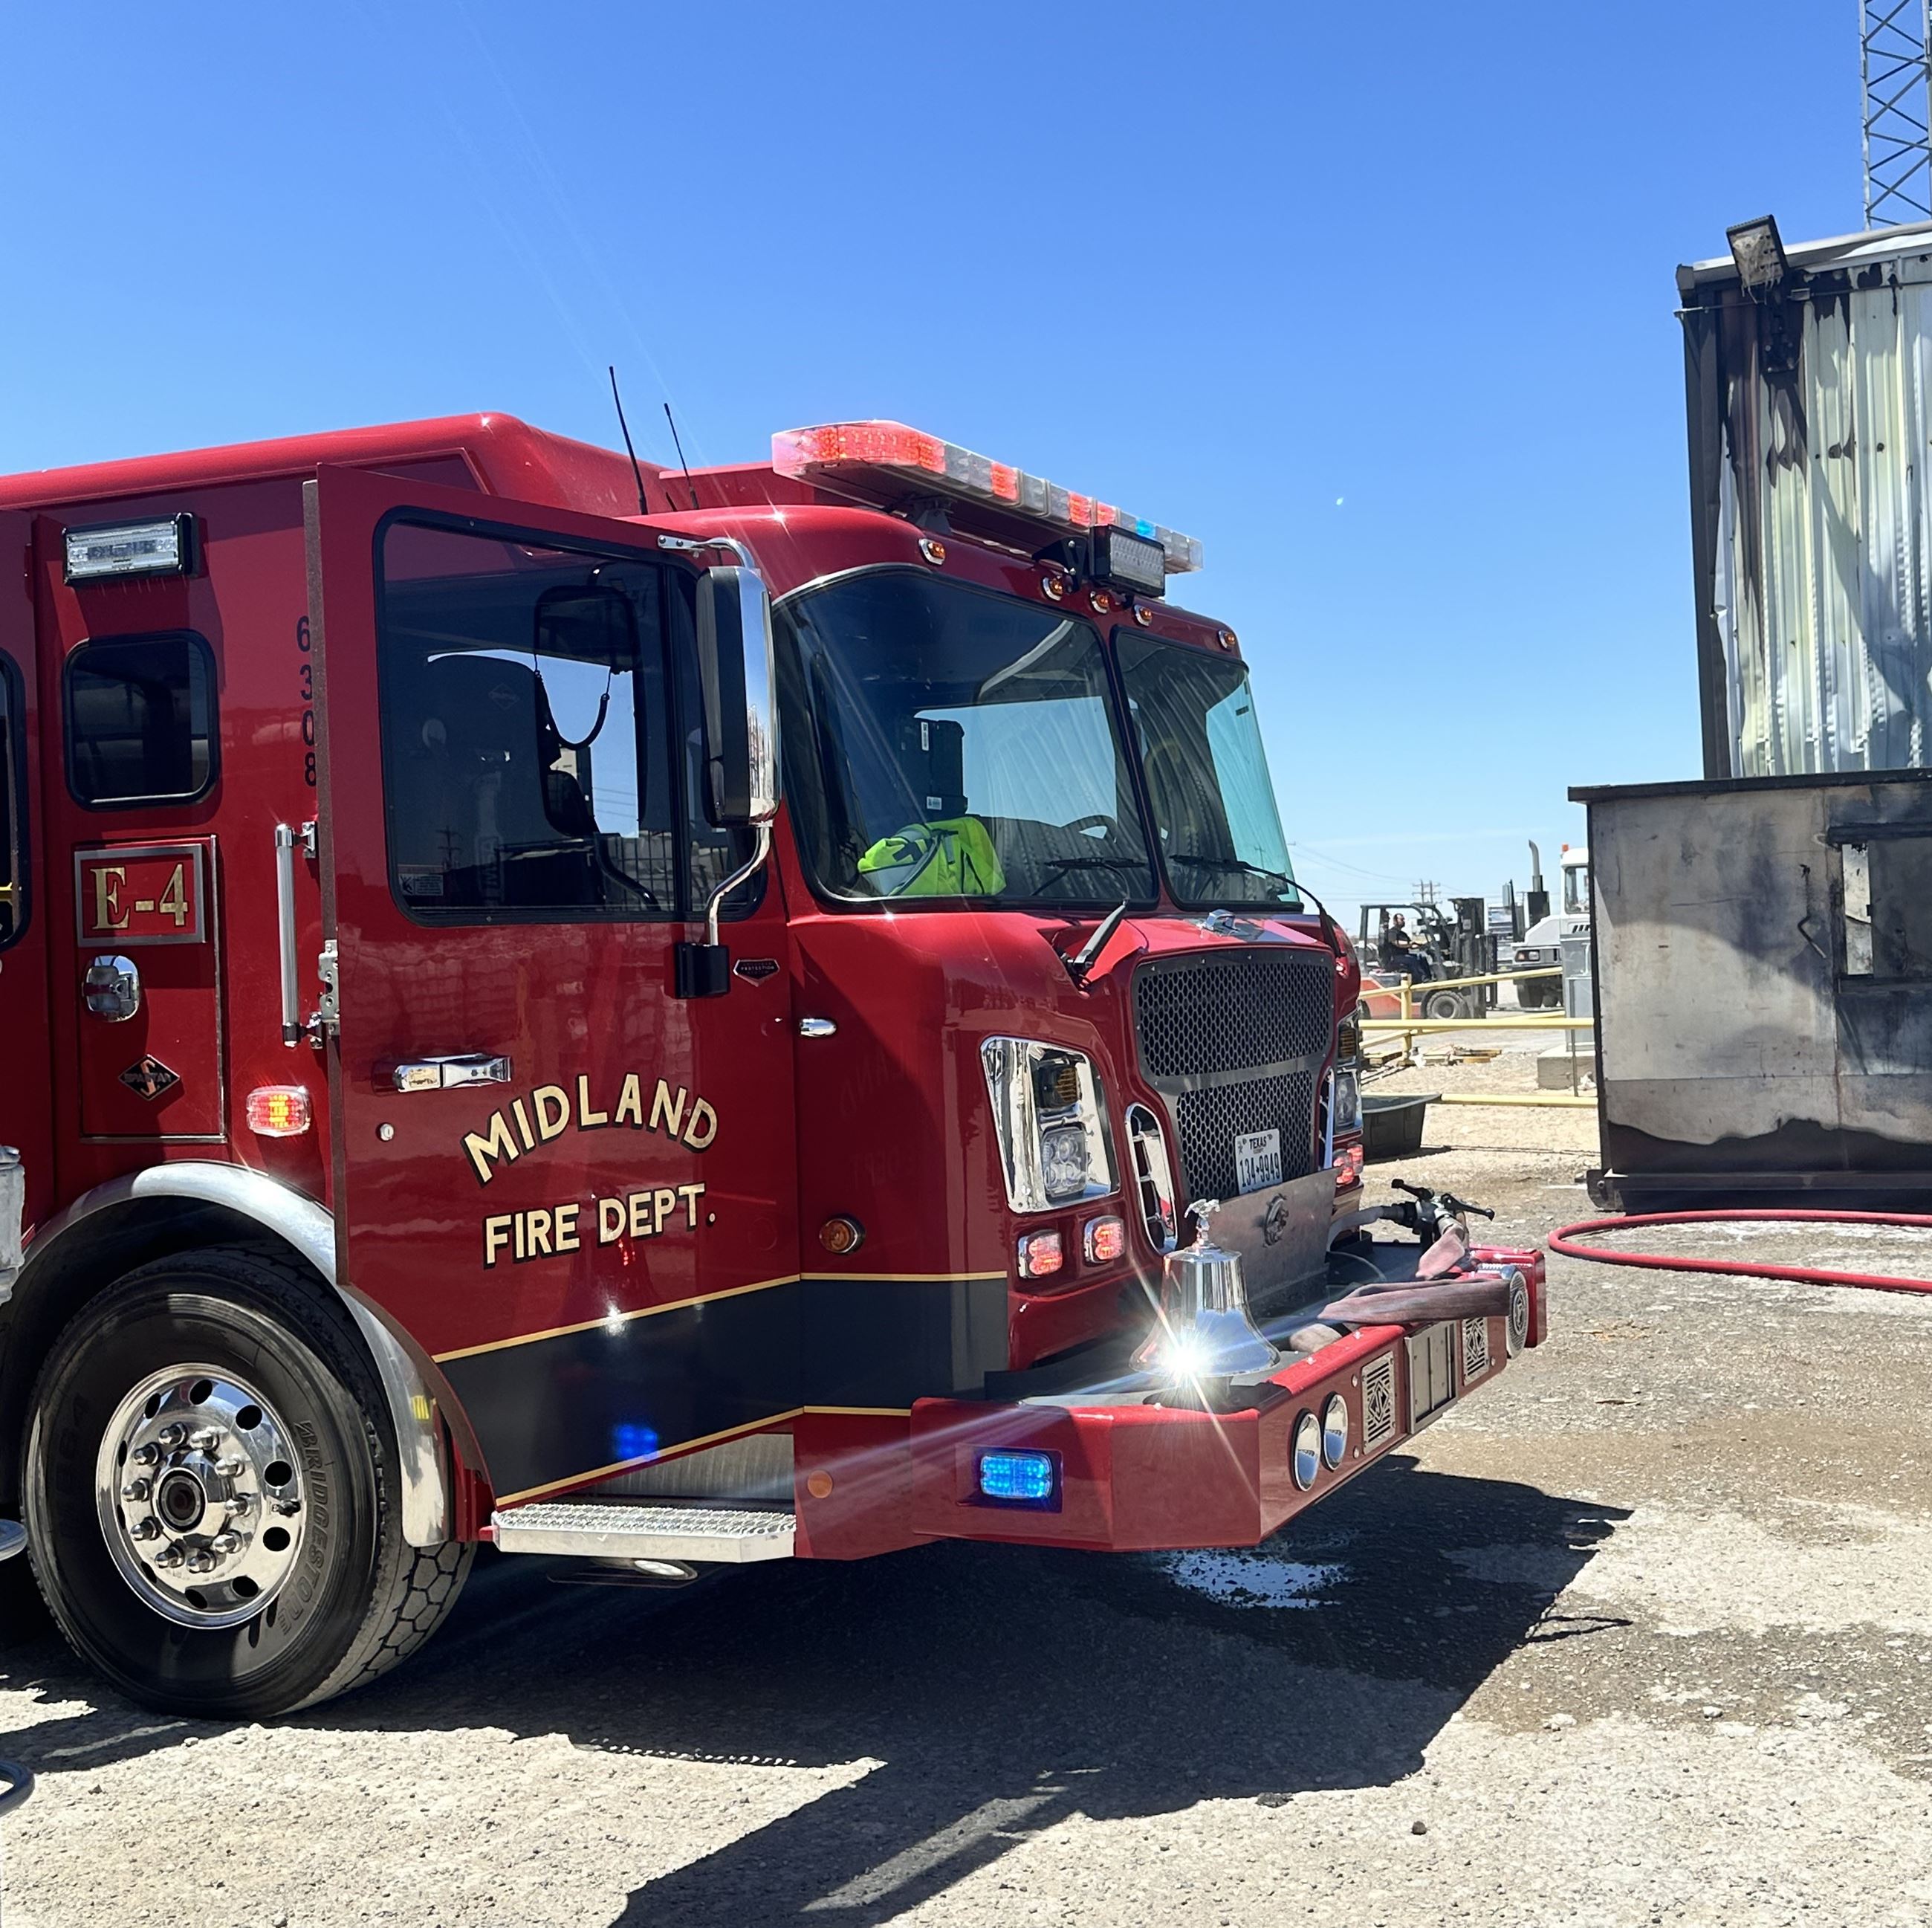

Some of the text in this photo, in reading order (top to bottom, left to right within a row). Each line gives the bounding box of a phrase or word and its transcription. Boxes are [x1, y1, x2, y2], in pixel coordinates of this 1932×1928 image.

[90, 864, 189, 929] E-4
[461, 1073, 718, 1185] MIDLAND
[484, 1183, 716, 1267] FIRE DEPT.
[278, 1420, 329, 1635] BRIDGESTONE
